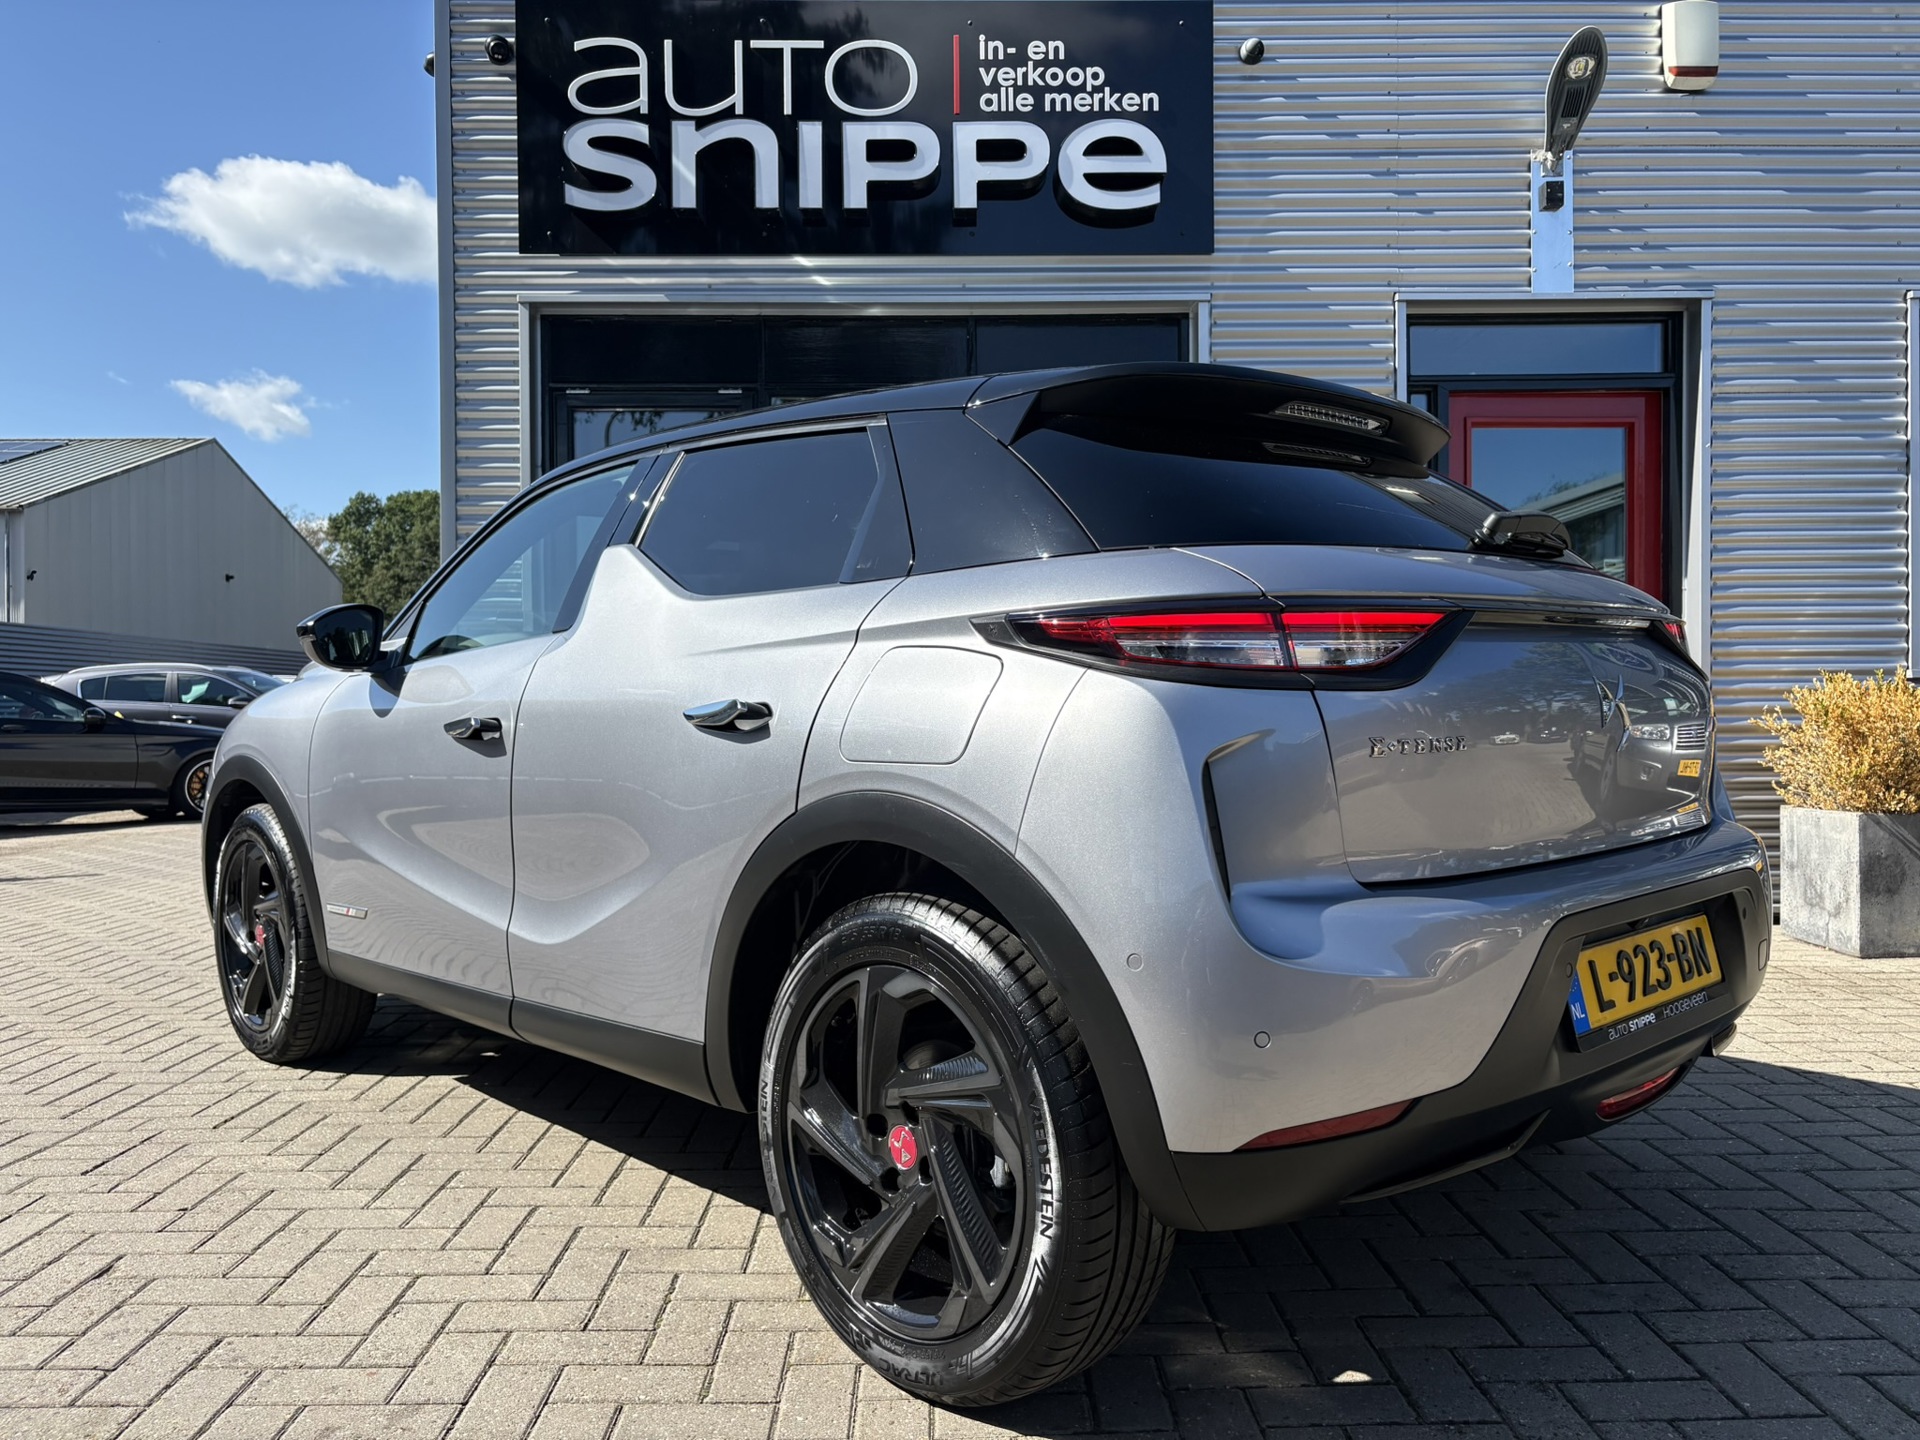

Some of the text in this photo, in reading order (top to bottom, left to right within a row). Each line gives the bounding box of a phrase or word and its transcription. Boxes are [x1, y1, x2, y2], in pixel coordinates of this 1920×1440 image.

[978, 34, 1065, 60] in- en
[978, 61, 1106, 92] verkoop
[979, 87, 1160, 112] alle merken
[1588, 927, 1712, 1013] L-923-BN
[1571, 1003, 1586, 1021] NL
[1027, 1088, 1055, 1240] VREDESTEIN
